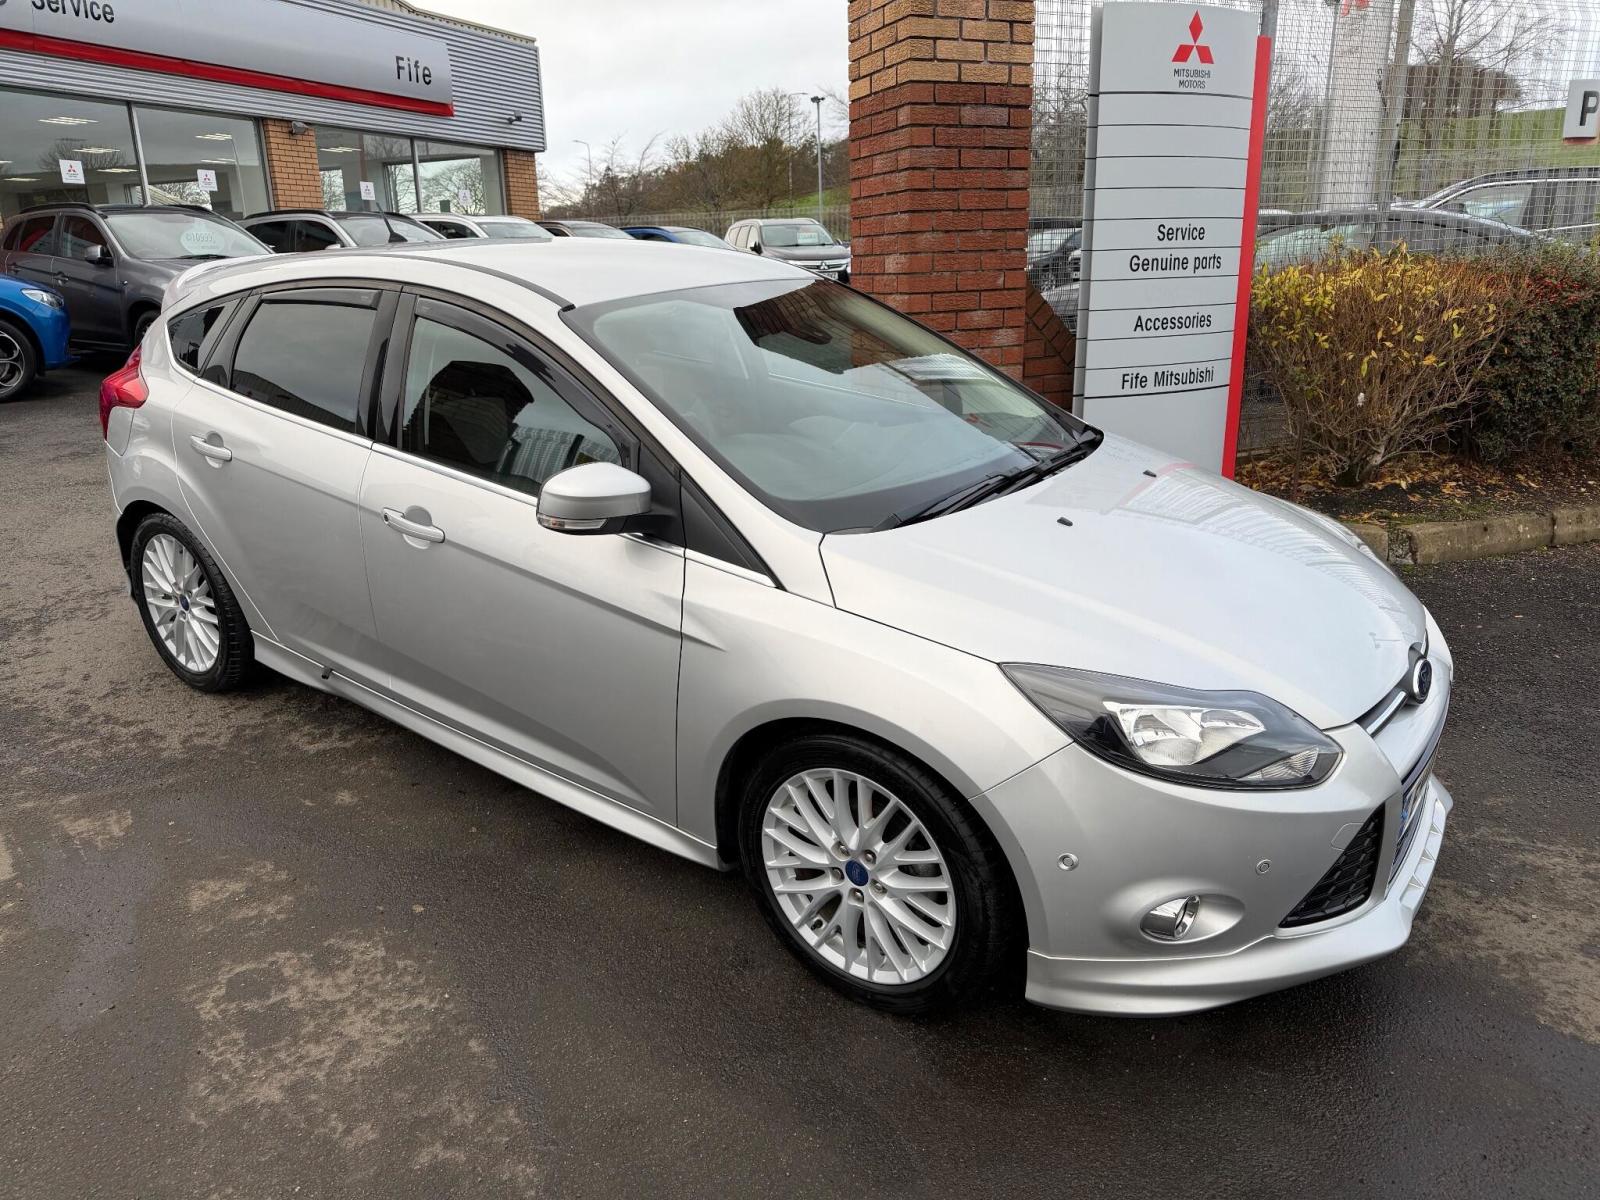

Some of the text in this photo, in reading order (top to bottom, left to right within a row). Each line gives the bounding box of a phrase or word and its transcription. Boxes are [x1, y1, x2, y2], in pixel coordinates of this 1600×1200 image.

[395, 55, 432, 86] Fife
[1173, 68, 1211, 79] MITSUBISHI
[1178, 79, 1206, 89] MOTORS
[1157, 223, 1206, 241] Service
[1129, 253, 1222, 274] Genuine parts
[1133, 312, 1212, 332] Accessories
[1121, 366, 1215, 390] Fife Mitsubishi
